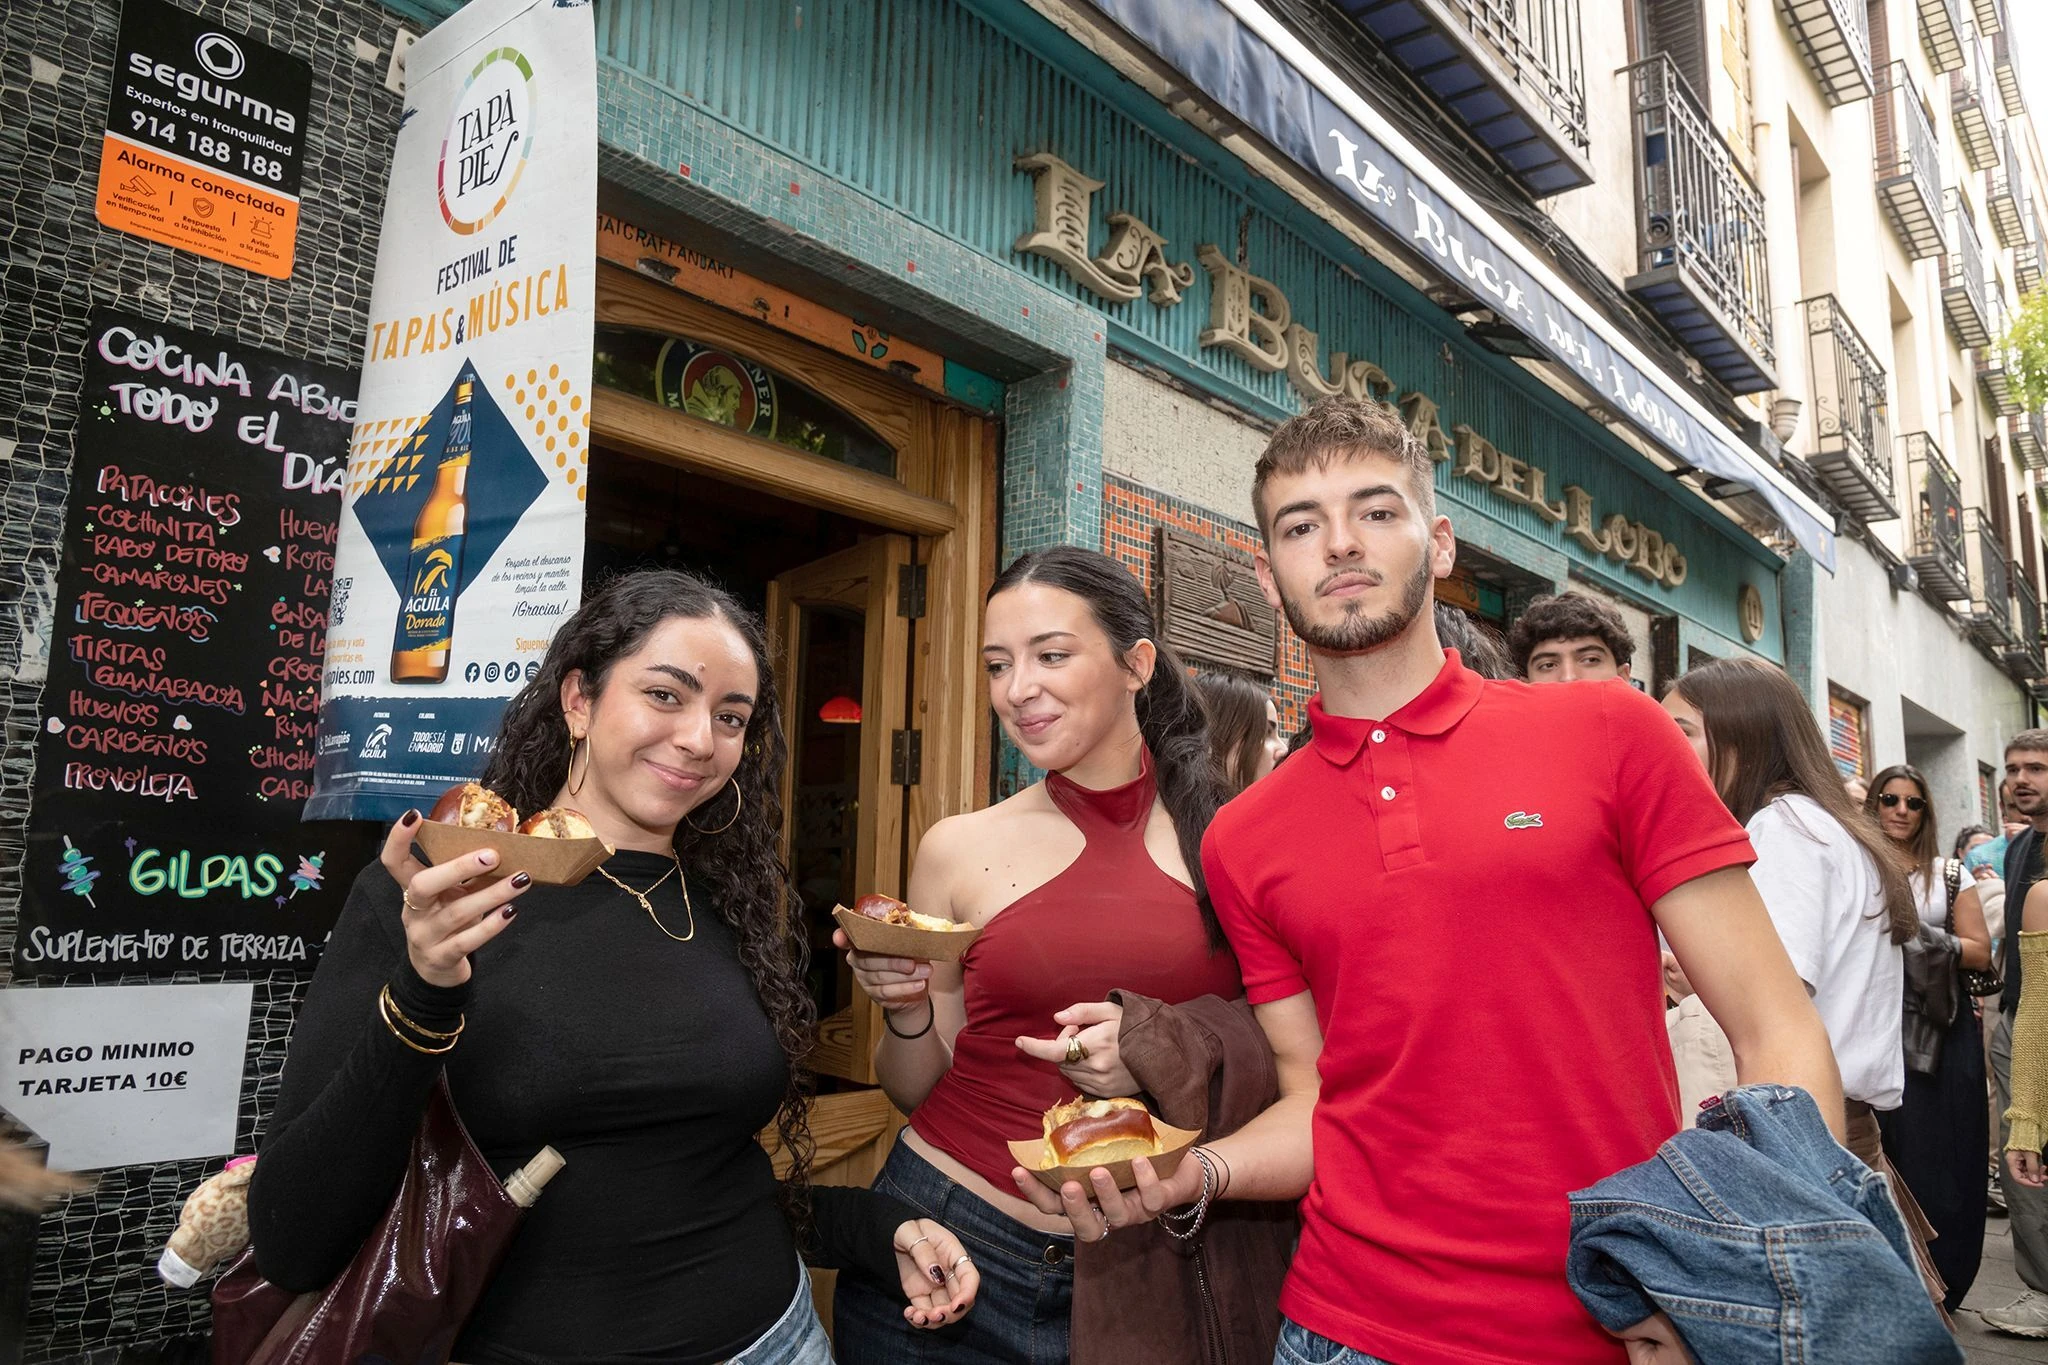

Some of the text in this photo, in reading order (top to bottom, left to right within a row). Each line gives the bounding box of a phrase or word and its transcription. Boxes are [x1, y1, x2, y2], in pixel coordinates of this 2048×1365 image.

[129, 52, 296, 134] segurma
[126, 85, 293, 156] Expertos en tranquilidad
[131, 110, 283, 182] 914 188 188
[112, 191, 161, 213] Verificación
[117, 149, 286, 217] Alarma conectada
[106, 199, 165, 223] en tiempo real
[182, 215, 221, 233] Respuesta
[181, 222, 190, 231] la
[190, 224, 227, 243] inhibición
[245, 242, 254, 251] la
[250, 237, 270, 249] Aviso
[437, 234, 518, 295] FESTIVAL DE
[98, 325, 358, 424] COCINA ABIE
[1013, 152, 1196, 308] LA
[1452, 423, 1567, 523] DEL
[1562, 484, 1688, 588] LOBO
[108, 381, 285, 453] TODO EL
[97, 464, 242, 527] PATACONES
[491, 571, 501, 583] de
[501, 571, 512, 582] los
[512, 571, 537, 582] vecinos
[536, 571, 543, 584] y
[505, 554, 571, 570] Respeta el descanso
[429, 588, 438, 597] EL
[514, 583, 538, 595] limpia
[538, 582, 547, 592] la
[76, 591, 214, 638] TEQUEÑOS
[405, 612, 447, 631] Dorada
[511, 598, 569, 618] ¡Gracias!
[70, 634, 167, 672] TIRITAS
[279, 629, 305, 649] DE
[95, 665, 246, 711] GUANABACOA
[66, 725, 208, 765] CARIBEÑOS
[65, 763, 199, 803] PROVOLETA
[129, 848, 285, 899] GILDAS
[22, 925, 174, 963] SUPLEMENTO
[182, 935, 209, 961] DE
[219, 931, 307, 963] TERRAZA
[18, 1041, 195, 1065] PAGO MINIMO
[18, 1070, 188, 1097] TARJETA 10€
